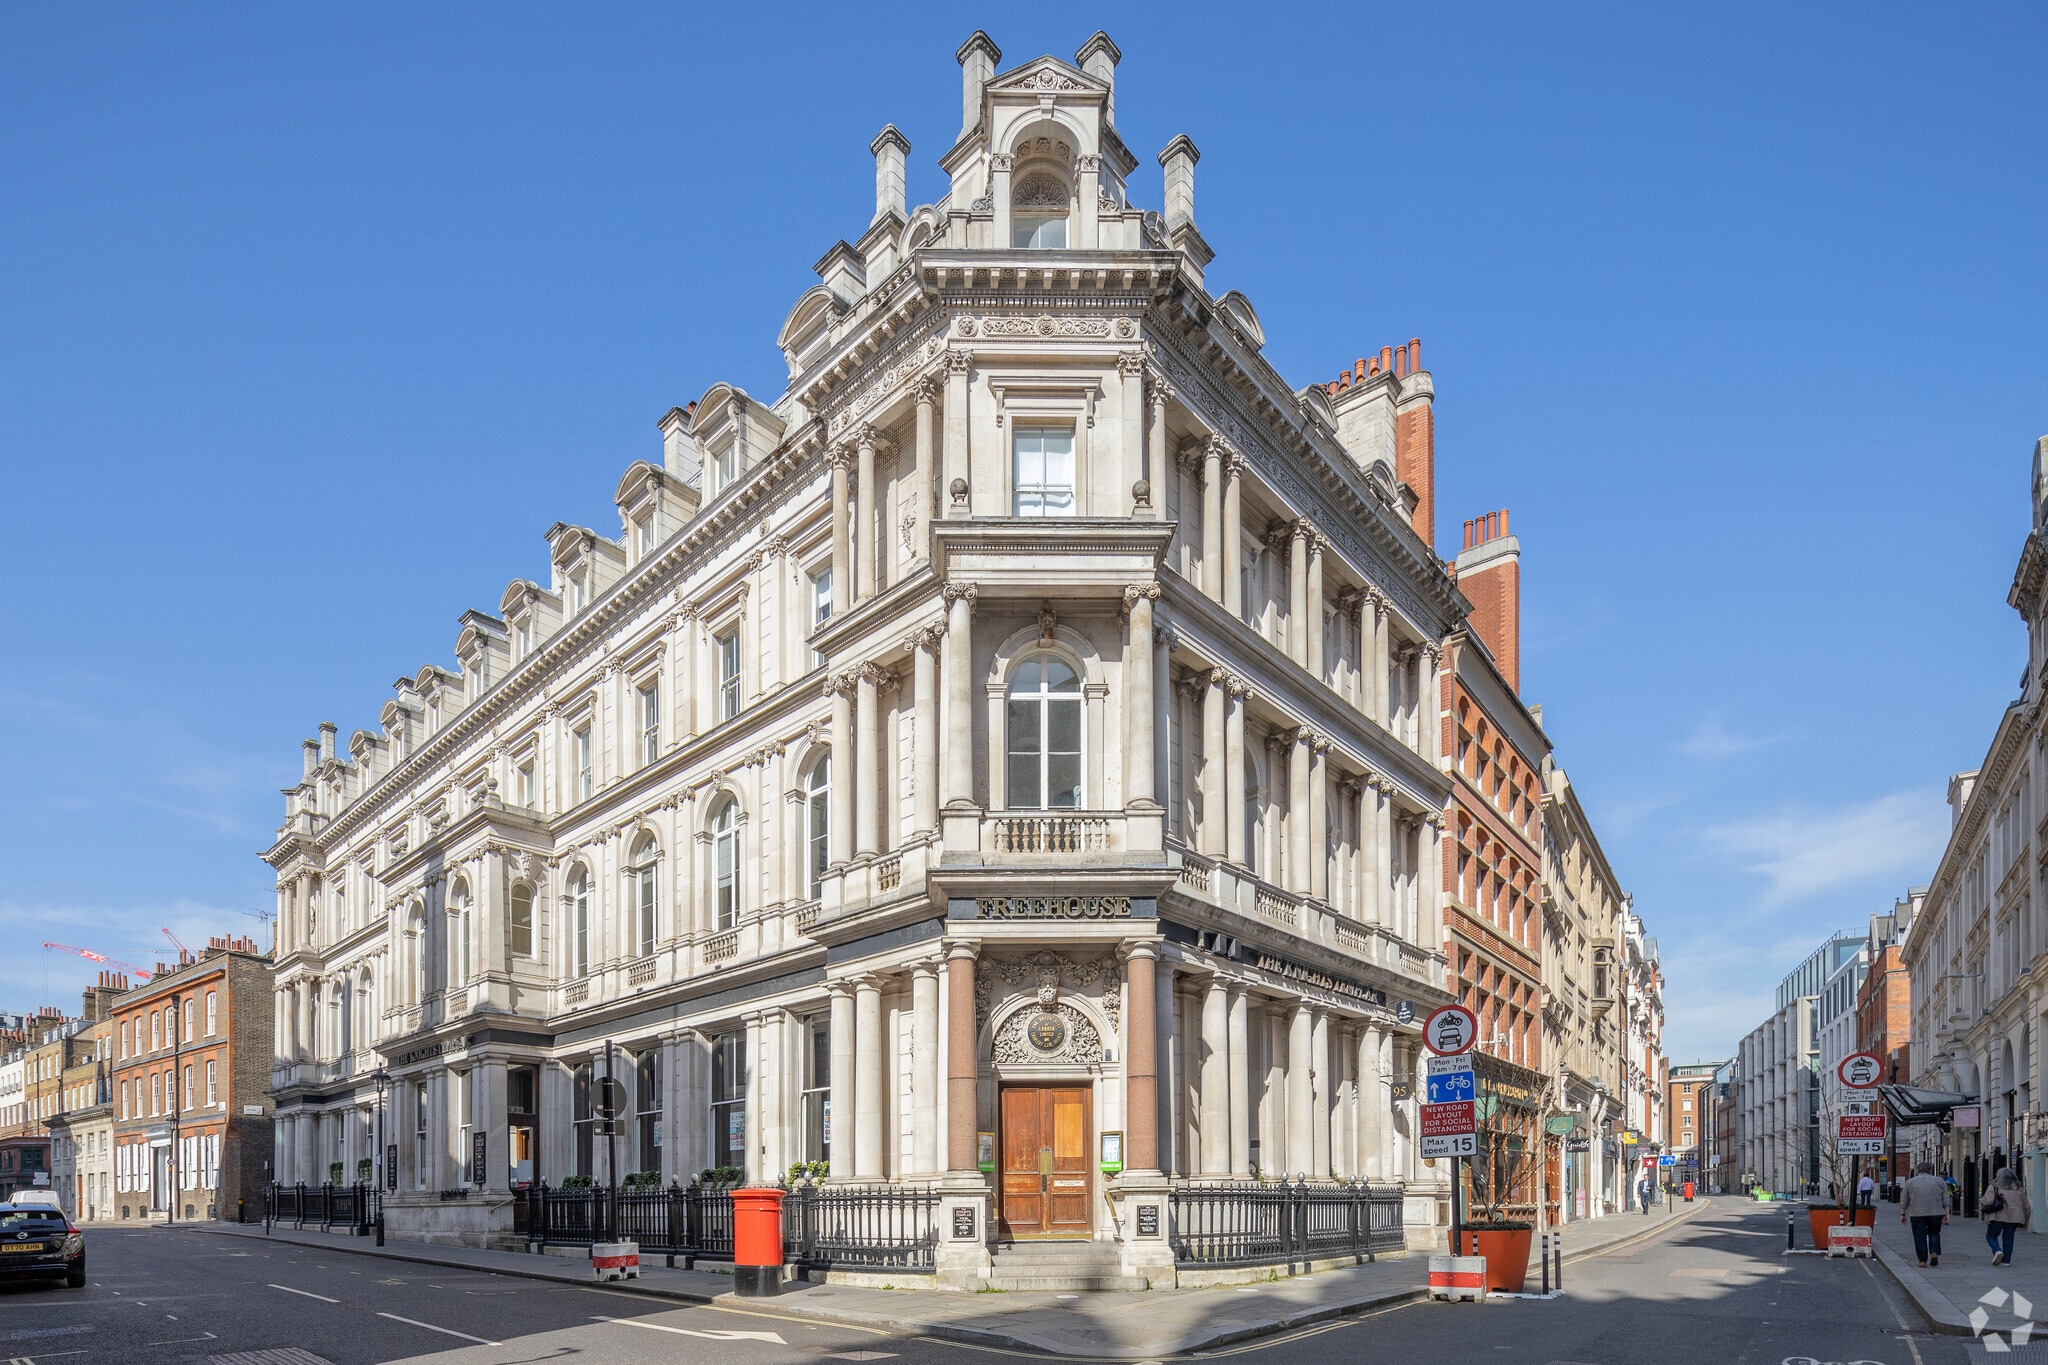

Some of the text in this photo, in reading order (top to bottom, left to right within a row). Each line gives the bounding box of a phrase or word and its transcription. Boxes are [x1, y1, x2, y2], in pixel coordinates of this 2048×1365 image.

[976, 897, 1131, 917] FREEHOUSE
[1434, 1059, 1450, 1067] Mon
[1393, 1086, 1407, 1097] 95
[1446, 1103, 1468, 1112] ROAD
[1433, 1111, 1462, 1120] LAYOUT
[1442, 1117, 1471, 1126] SOCIAL
[1424, 1124, 1473, 1134] DISTANCING
[1452, 1137, 1473, 1152] 15
[1864, 1142, 1881, 1152] 15
[1424, 1146, 1449, 1155] speed
